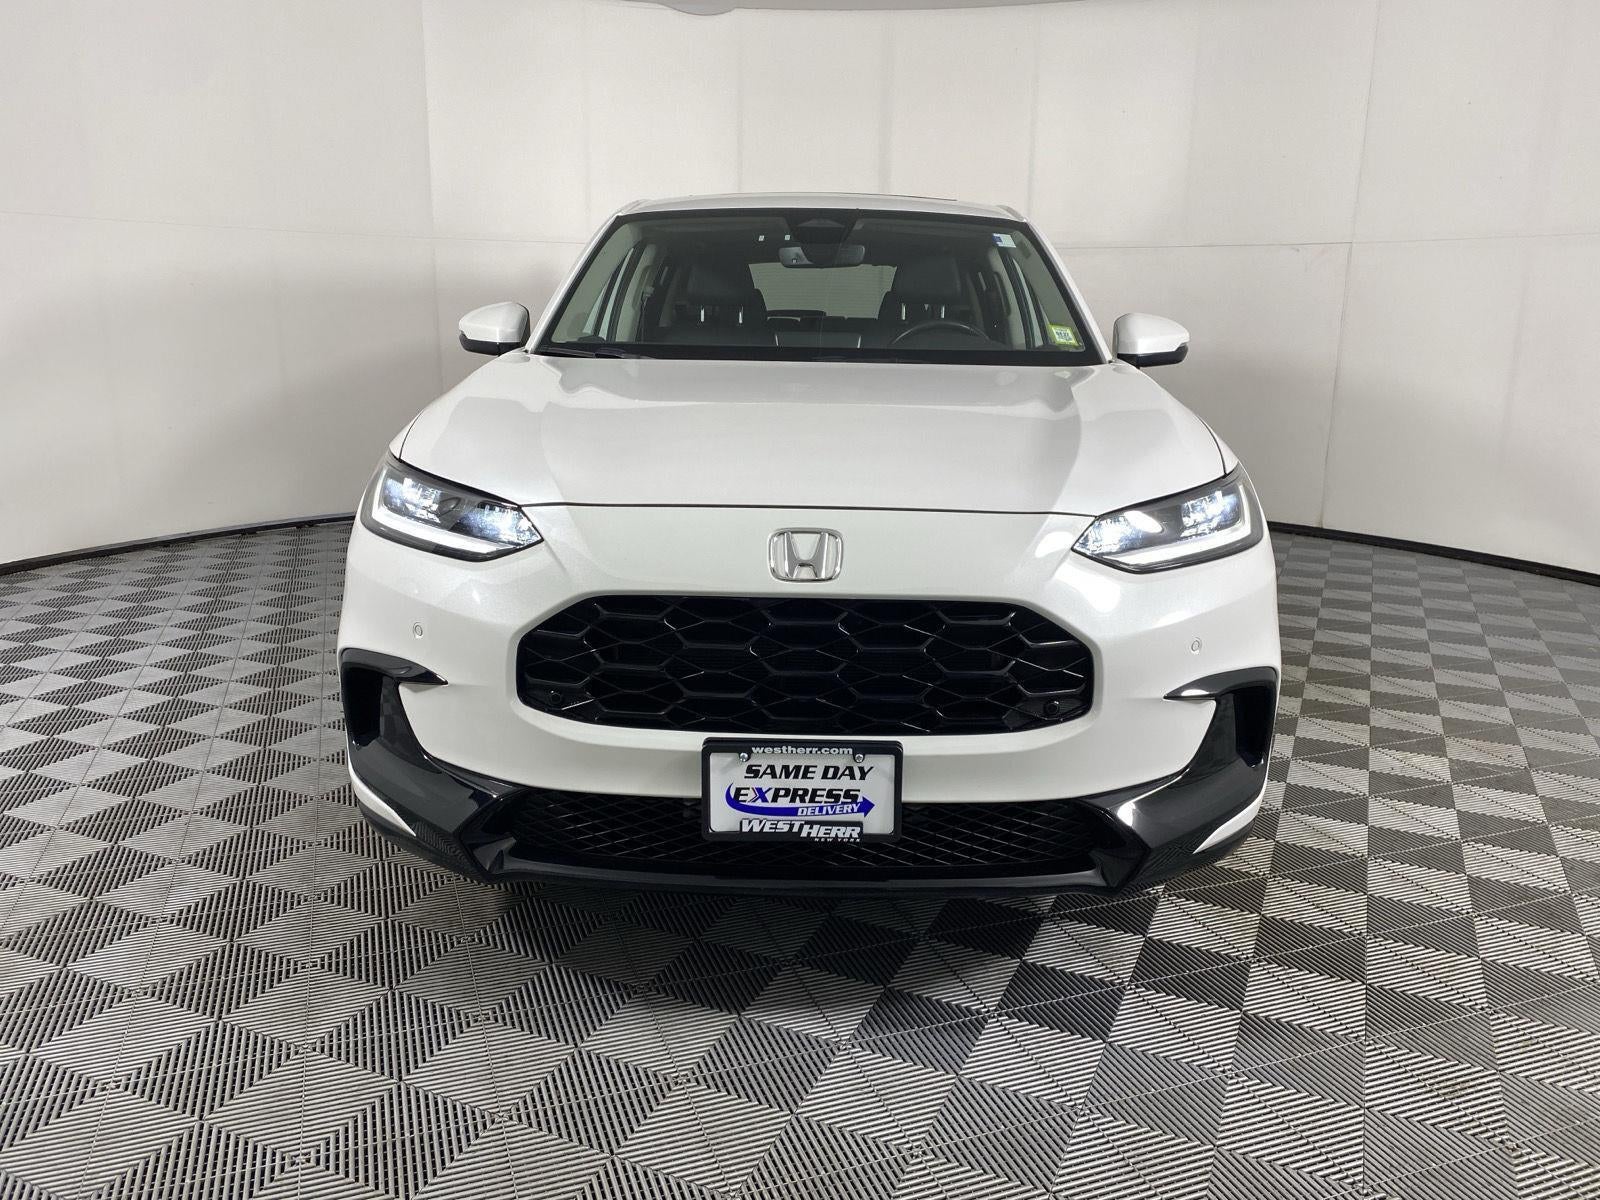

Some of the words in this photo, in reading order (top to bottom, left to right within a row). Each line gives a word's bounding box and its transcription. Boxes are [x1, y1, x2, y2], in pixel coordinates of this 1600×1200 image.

[751, 745, 853, 755] westherr.com
[744, 764, 818, 779] SAME
[821, 765, 874, 781] DAY
[733, 787, 861, 803] EXPRESS
[797, 803, 861, 816] DELIVERY
